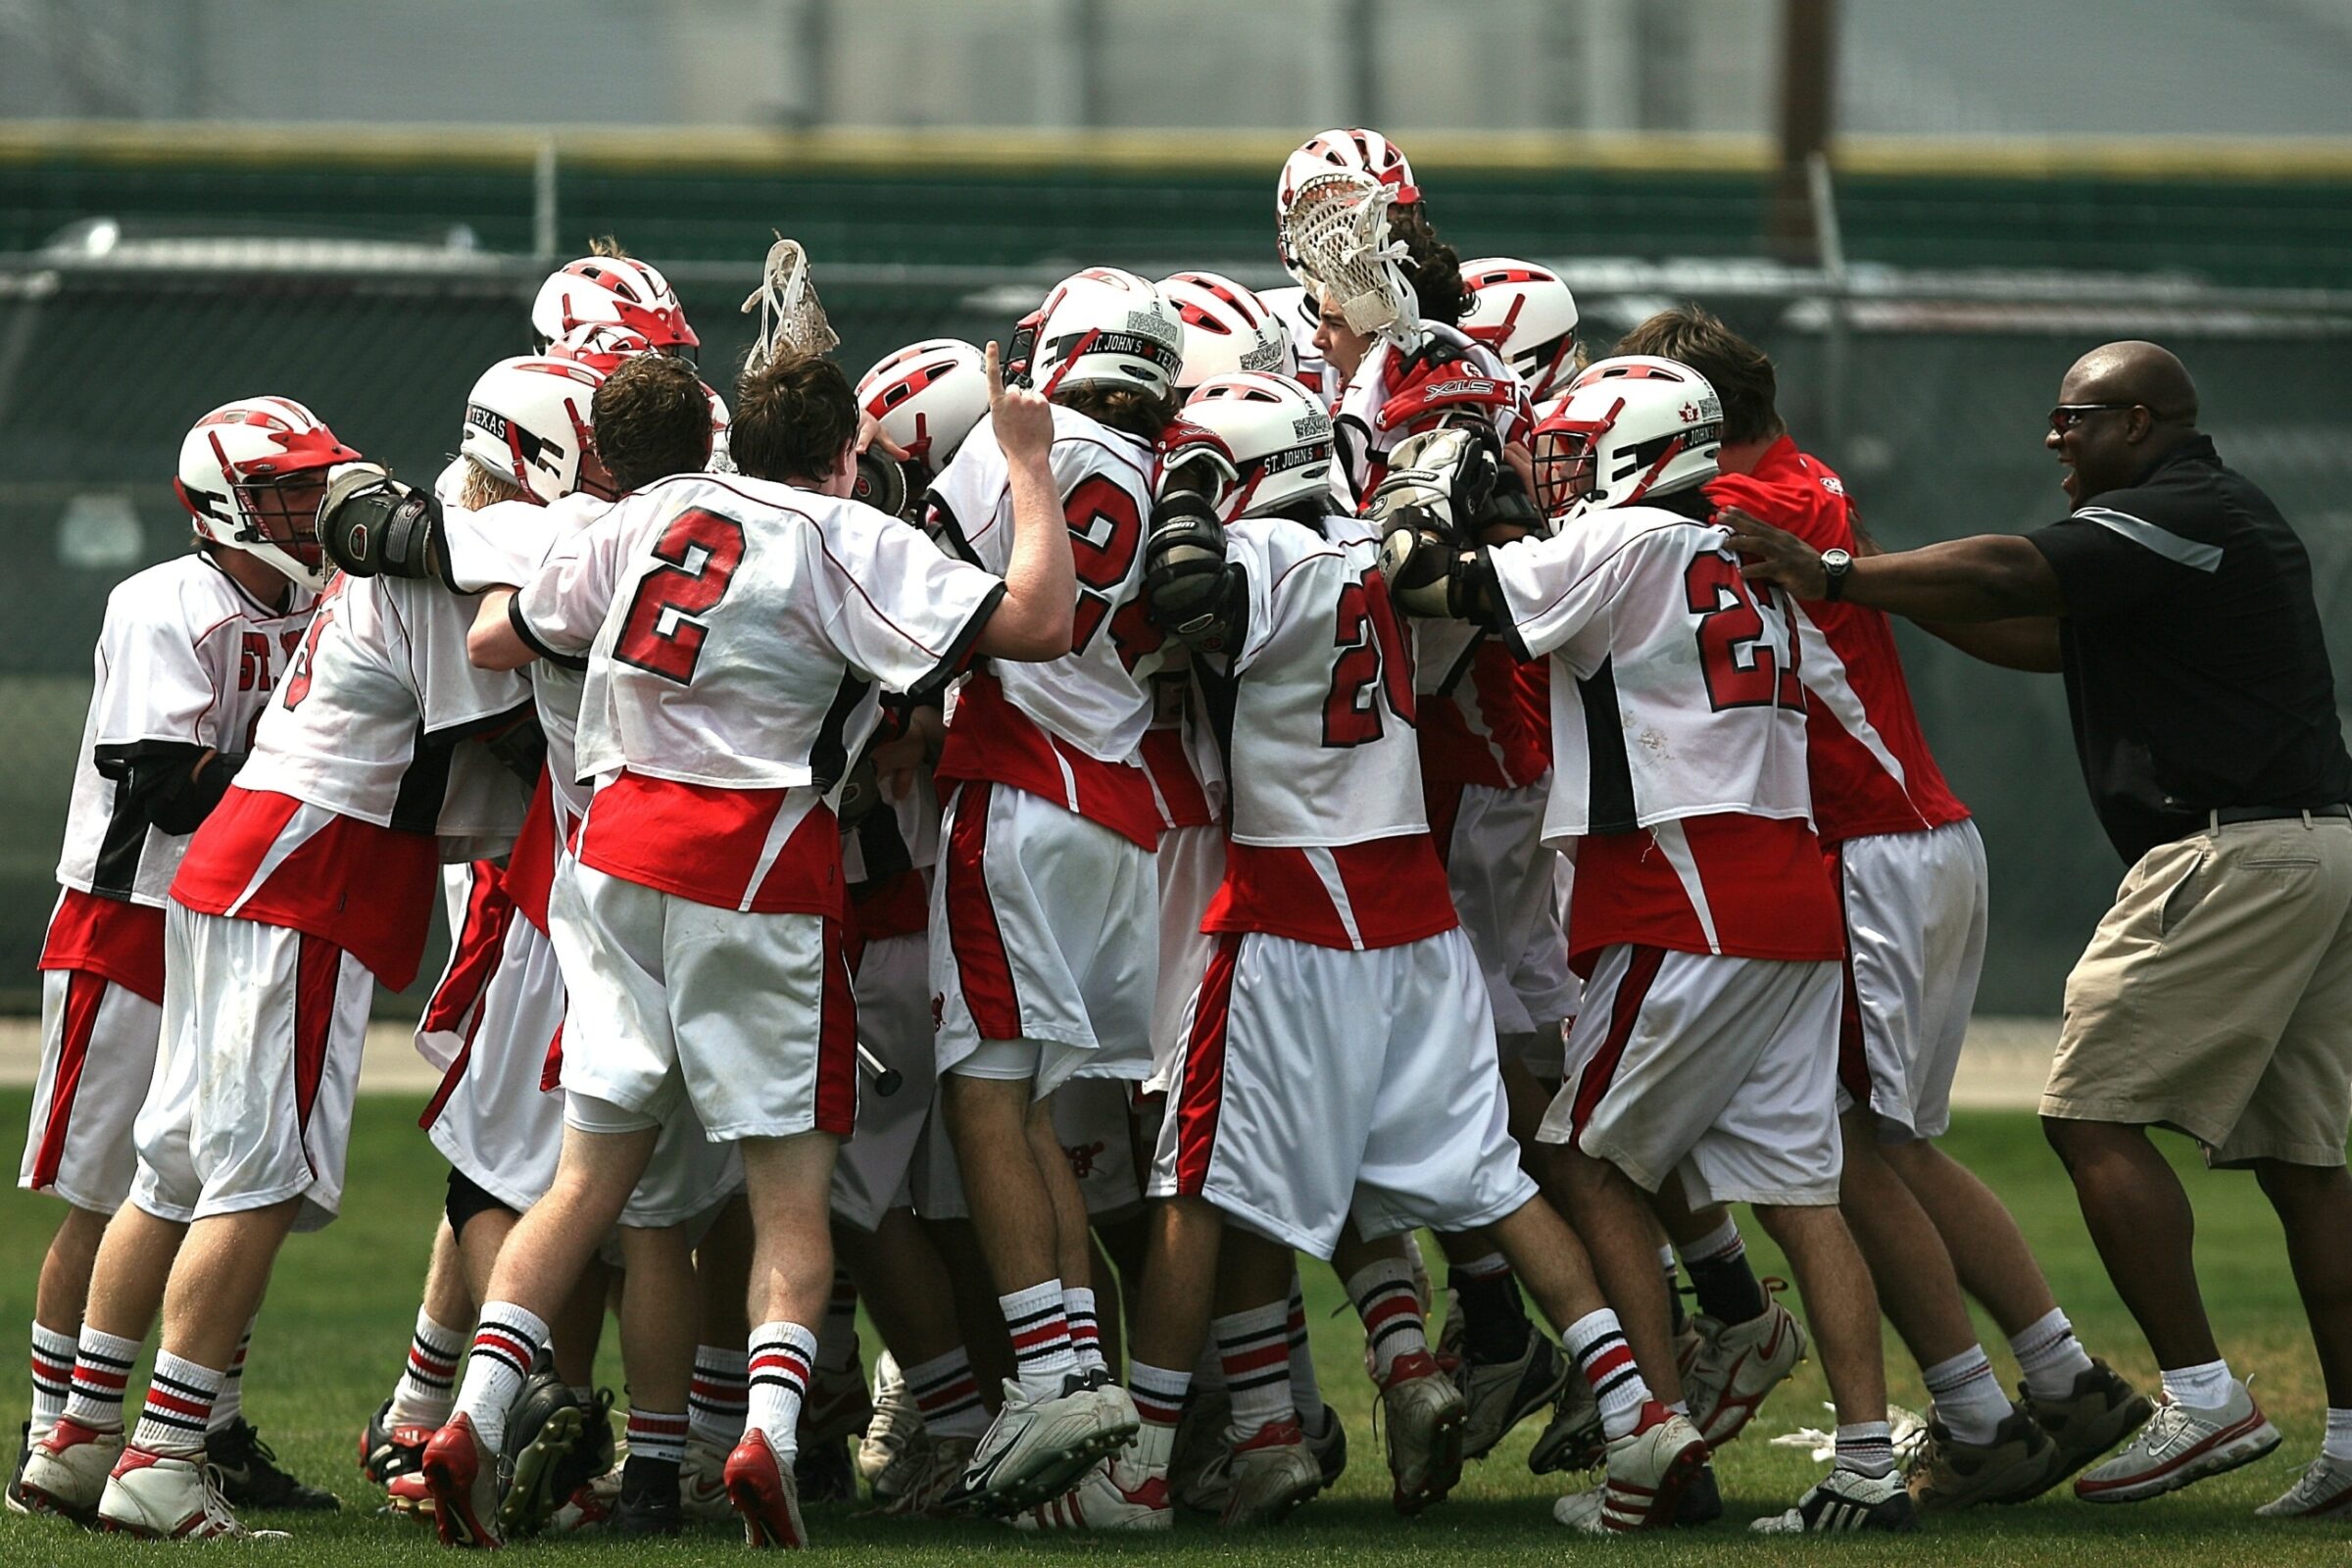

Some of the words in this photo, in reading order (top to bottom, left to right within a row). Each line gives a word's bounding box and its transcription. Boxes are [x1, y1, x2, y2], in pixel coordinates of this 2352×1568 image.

[471, 407, 507, 439] TEXAS
[1263, 457, 1281, 476] ST.
[612, 505, 748, 687] 2
